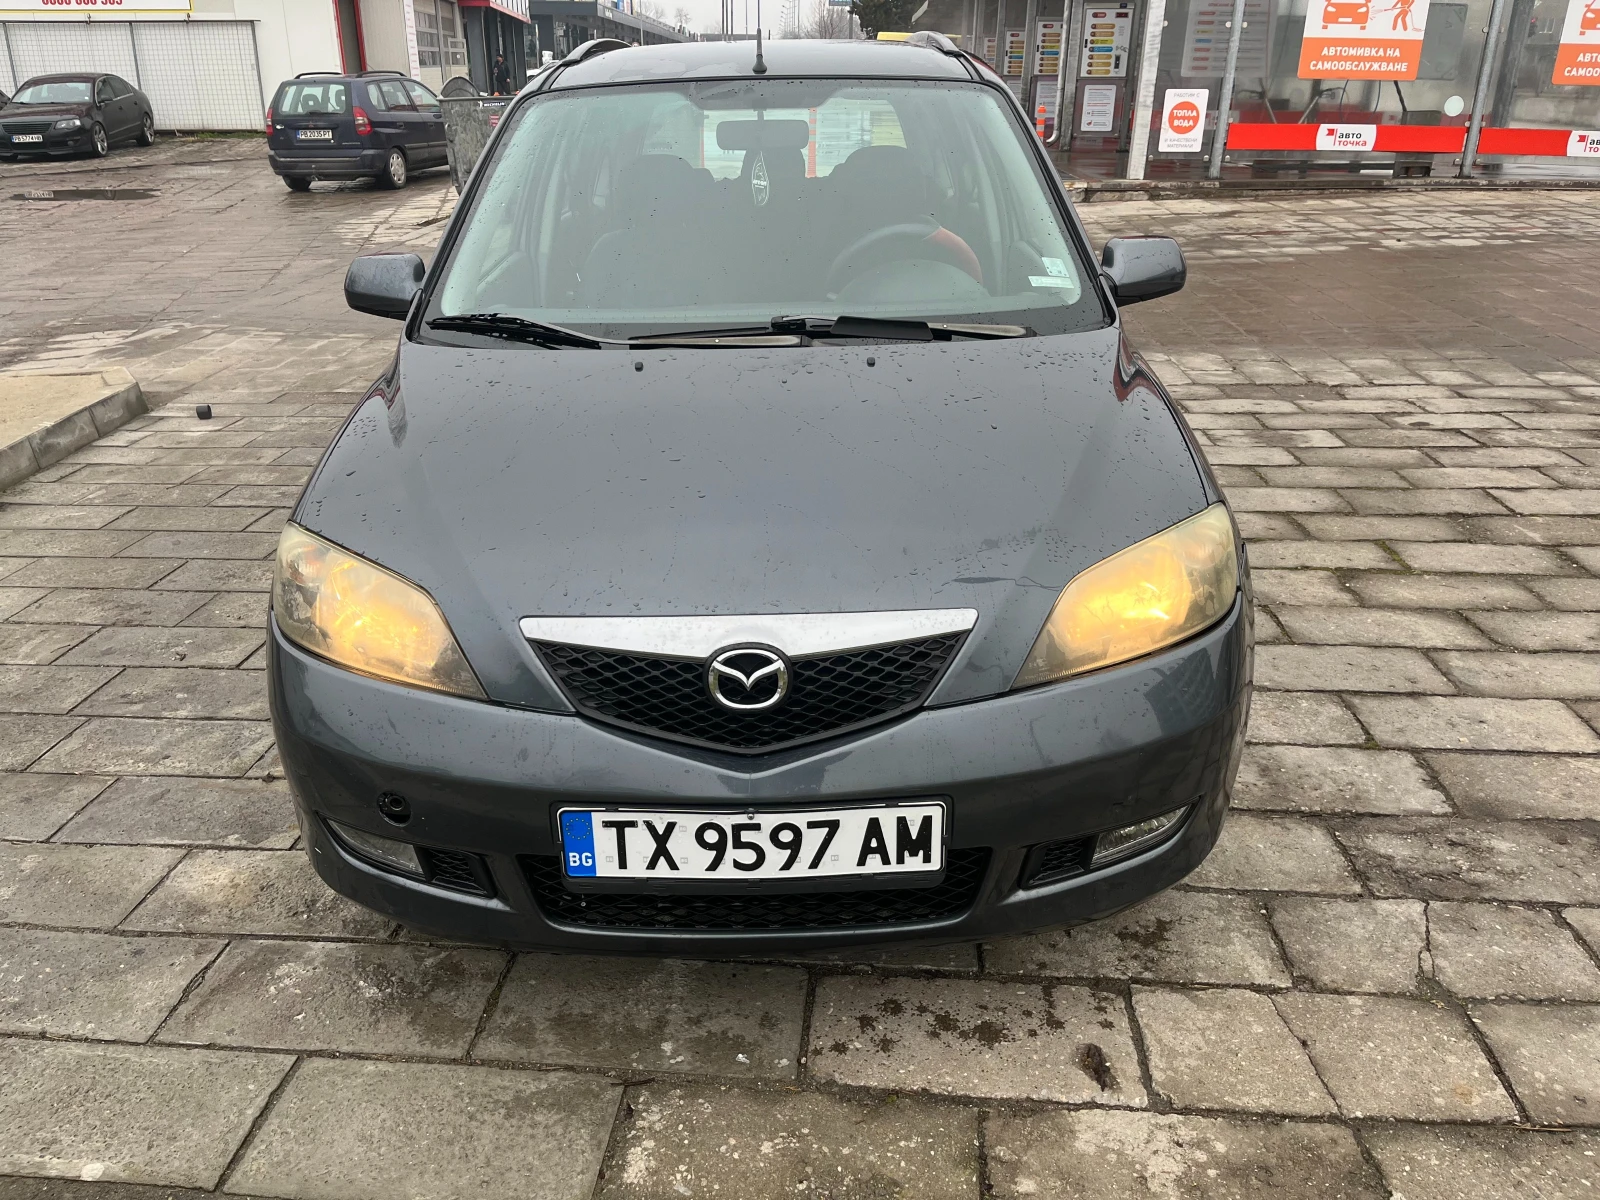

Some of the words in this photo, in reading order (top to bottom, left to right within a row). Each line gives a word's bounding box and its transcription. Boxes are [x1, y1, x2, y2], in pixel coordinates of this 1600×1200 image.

[1321, 46, 1384, 57] АВТОМИВКА
[1386, 48, 1401, 57] НА
[1310, 60, 1408, 72] САМООБСЛУЖВАНЕ
[1173, 109, 1197, 117] ТОПЛА
[1173, 119, 1194, 127] ВОДА
[602, 819, 680, 871] TX
[694, 818, 841, 873] 9597
[856, 815, 933, 867] AM
[569, 851, 593, 867] BG
